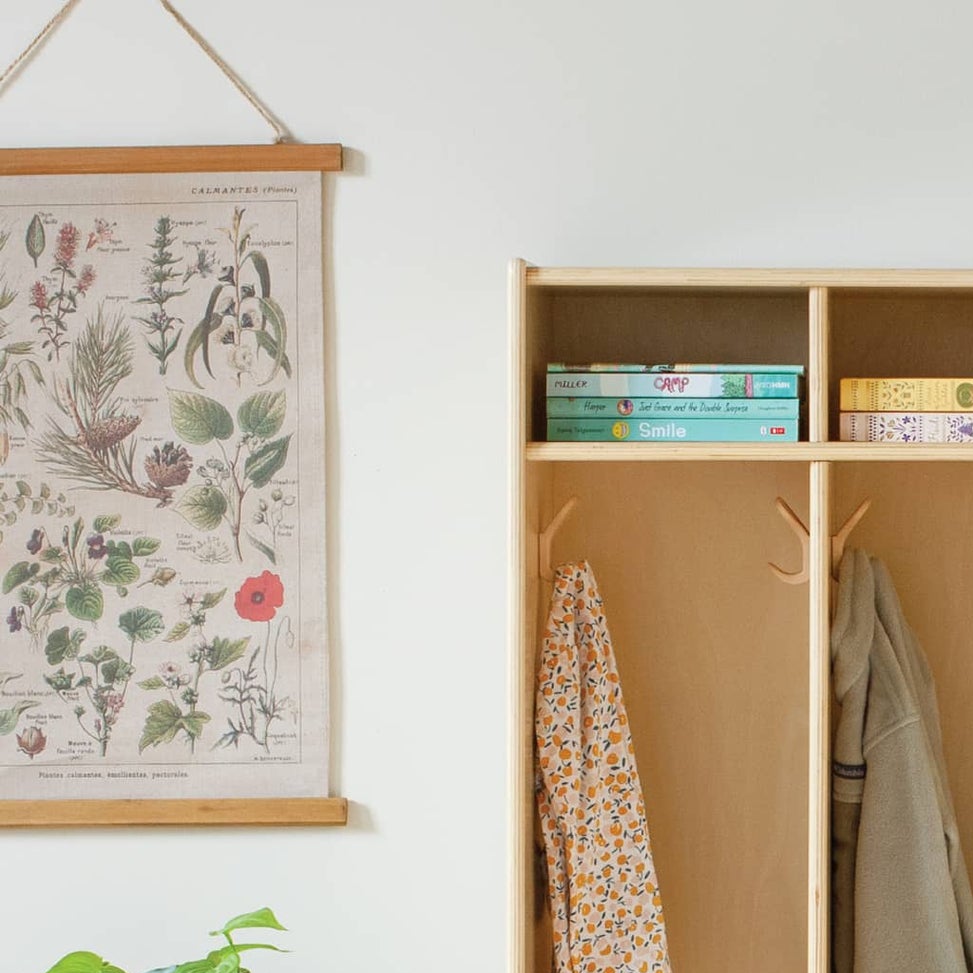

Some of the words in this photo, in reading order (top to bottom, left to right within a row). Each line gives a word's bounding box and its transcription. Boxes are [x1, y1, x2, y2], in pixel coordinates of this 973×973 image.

[191, 186, 259, 195] CALMANTES
[554, 380, 588, 389] MILLER
[653, 376, 690, 393] CAMP
[639, 422, 687, 438] Smile
